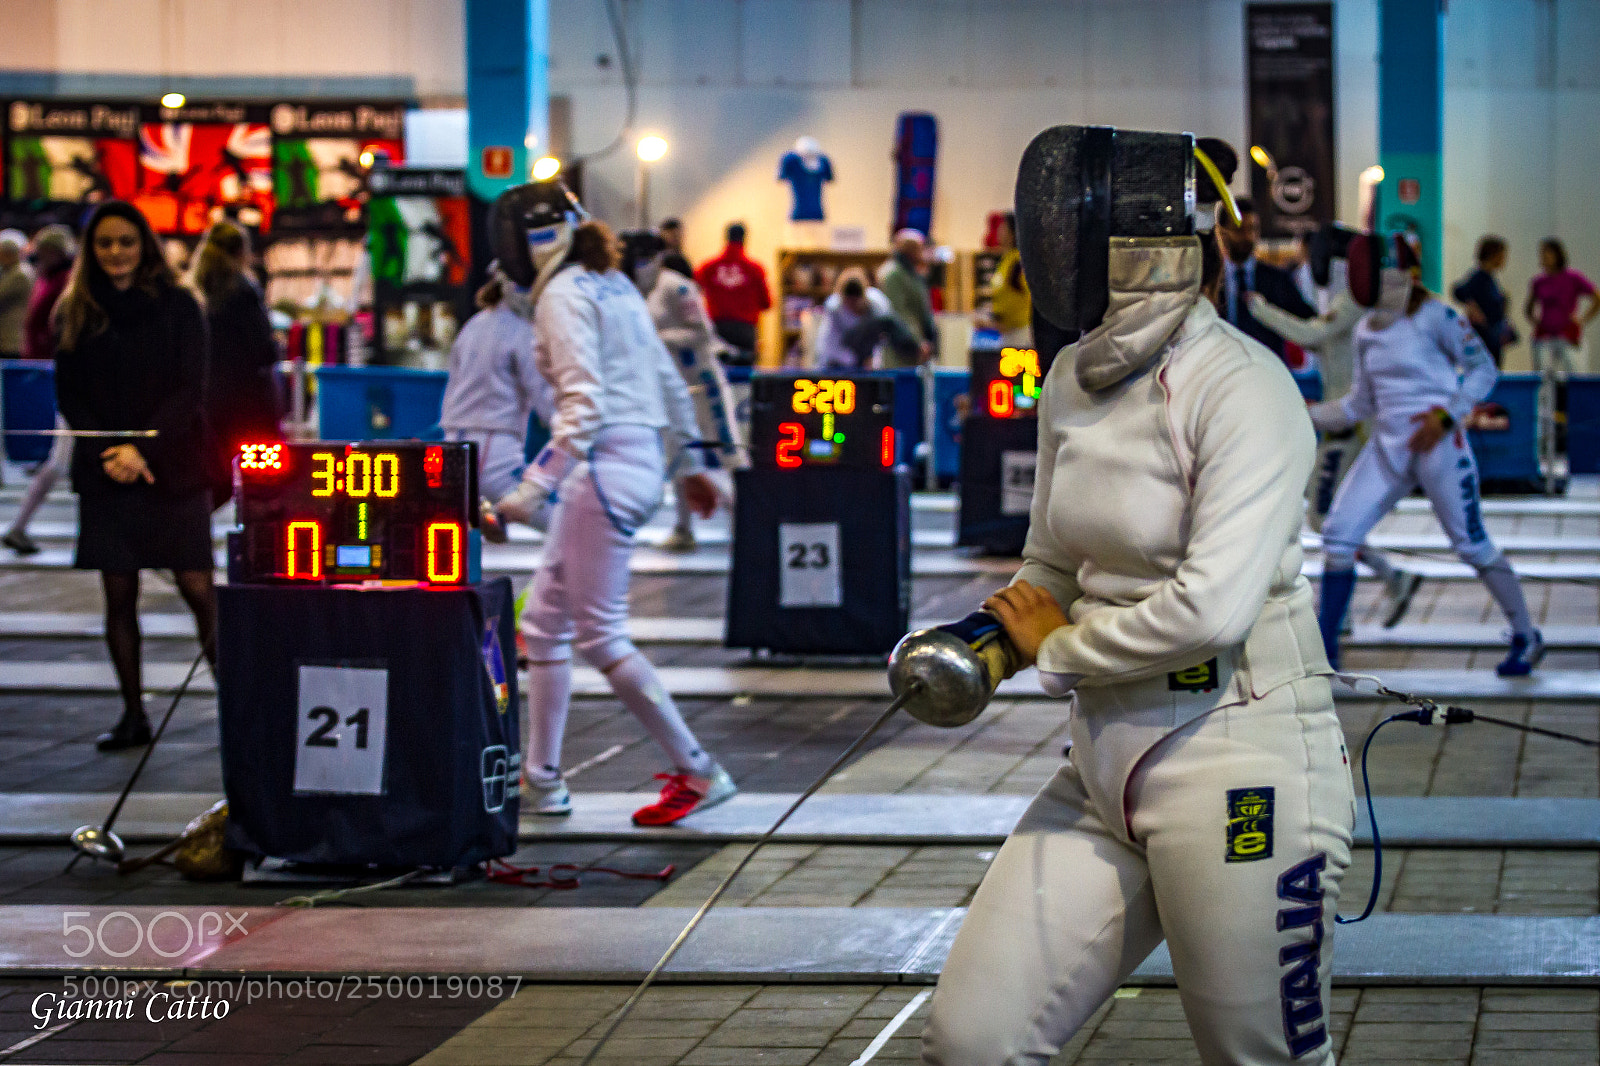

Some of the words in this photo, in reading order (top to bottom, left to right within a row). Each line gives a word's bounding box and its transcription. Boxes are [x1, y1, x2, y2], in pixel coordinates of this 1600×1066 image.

[792, 379, 856, 414] 2:20
[988, 380, 1013, 417] 0
[776, 422, 805, 468] 2
[882, 426, 895, 467] 1
[311, 453, 399, 497] 3:00
[427, 522, 460, 582] 0
[788, 543, 830, 569] 23
[305, 706, 370, 749] 21
[1277, 852, 1327, 1060] ITALIA
